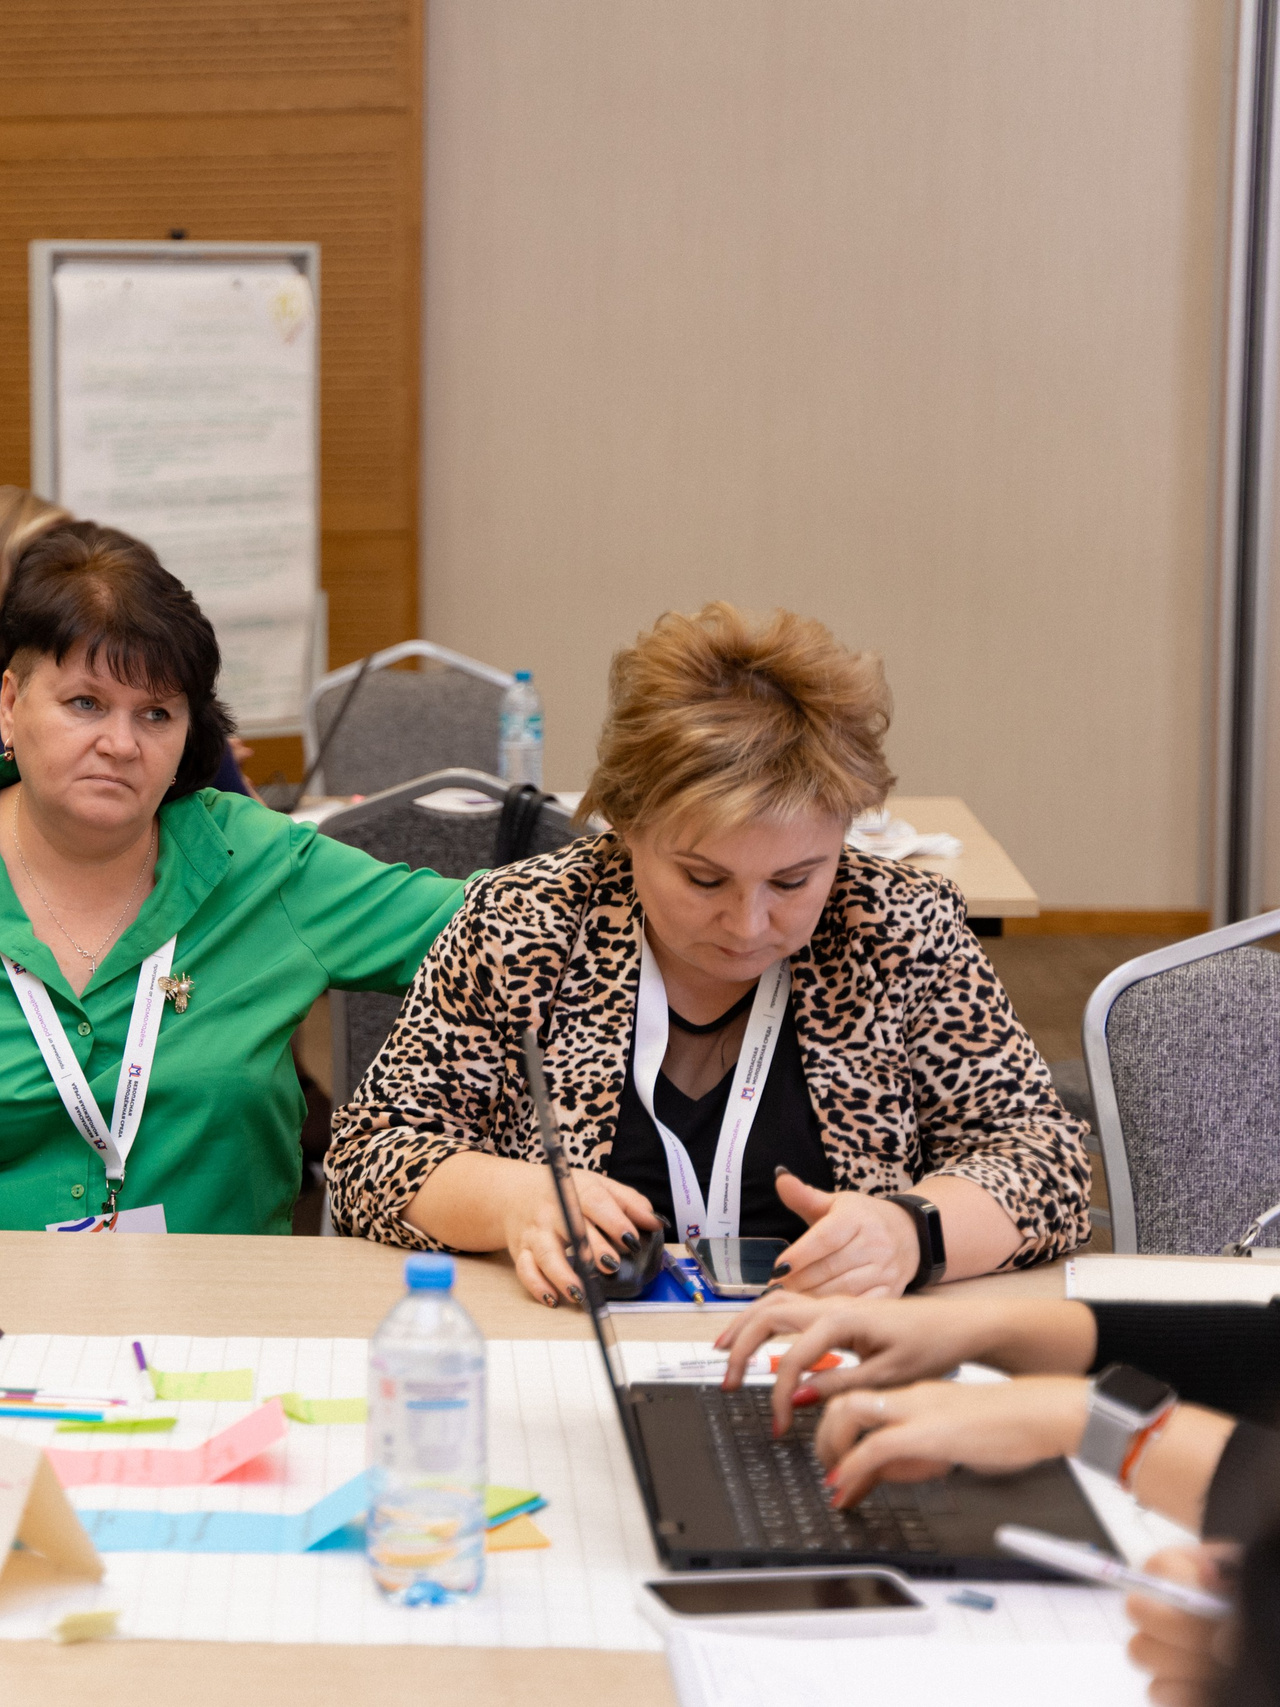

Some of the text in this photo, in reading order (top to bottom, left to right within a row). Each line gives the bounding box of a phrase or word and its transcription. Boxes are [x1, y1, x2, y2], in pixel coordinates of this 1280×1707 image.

[148, 963, 159, 990] программа
[24, 988, 52, 1037] росмолодёжь
[135, 997, 153, 1048] росмолодёжь
[49, 1042, 66, 1070] программа
[744, 1046, 759, 1084] БЕЗОПАСНАЯ
[750, 1024, 773, 1085] МОЛОДЁЖНАЯ СРЕДА
[69, 1081, 100, 1137] МОЛОДЁЖНАЯ СРЕДА
[116, 1078, 133, 1138] МОЛОДЁЖНАЯ СРЕДА
[126, 1079, 139, 1116] БЕЗОПАСНАЯ
[73, 1104, 95, 1139] БЕЗОПАСНАЯ
[723, 1117, 742, 1173] росмолодёжь
[720, 1181, 730, 1214] программа
